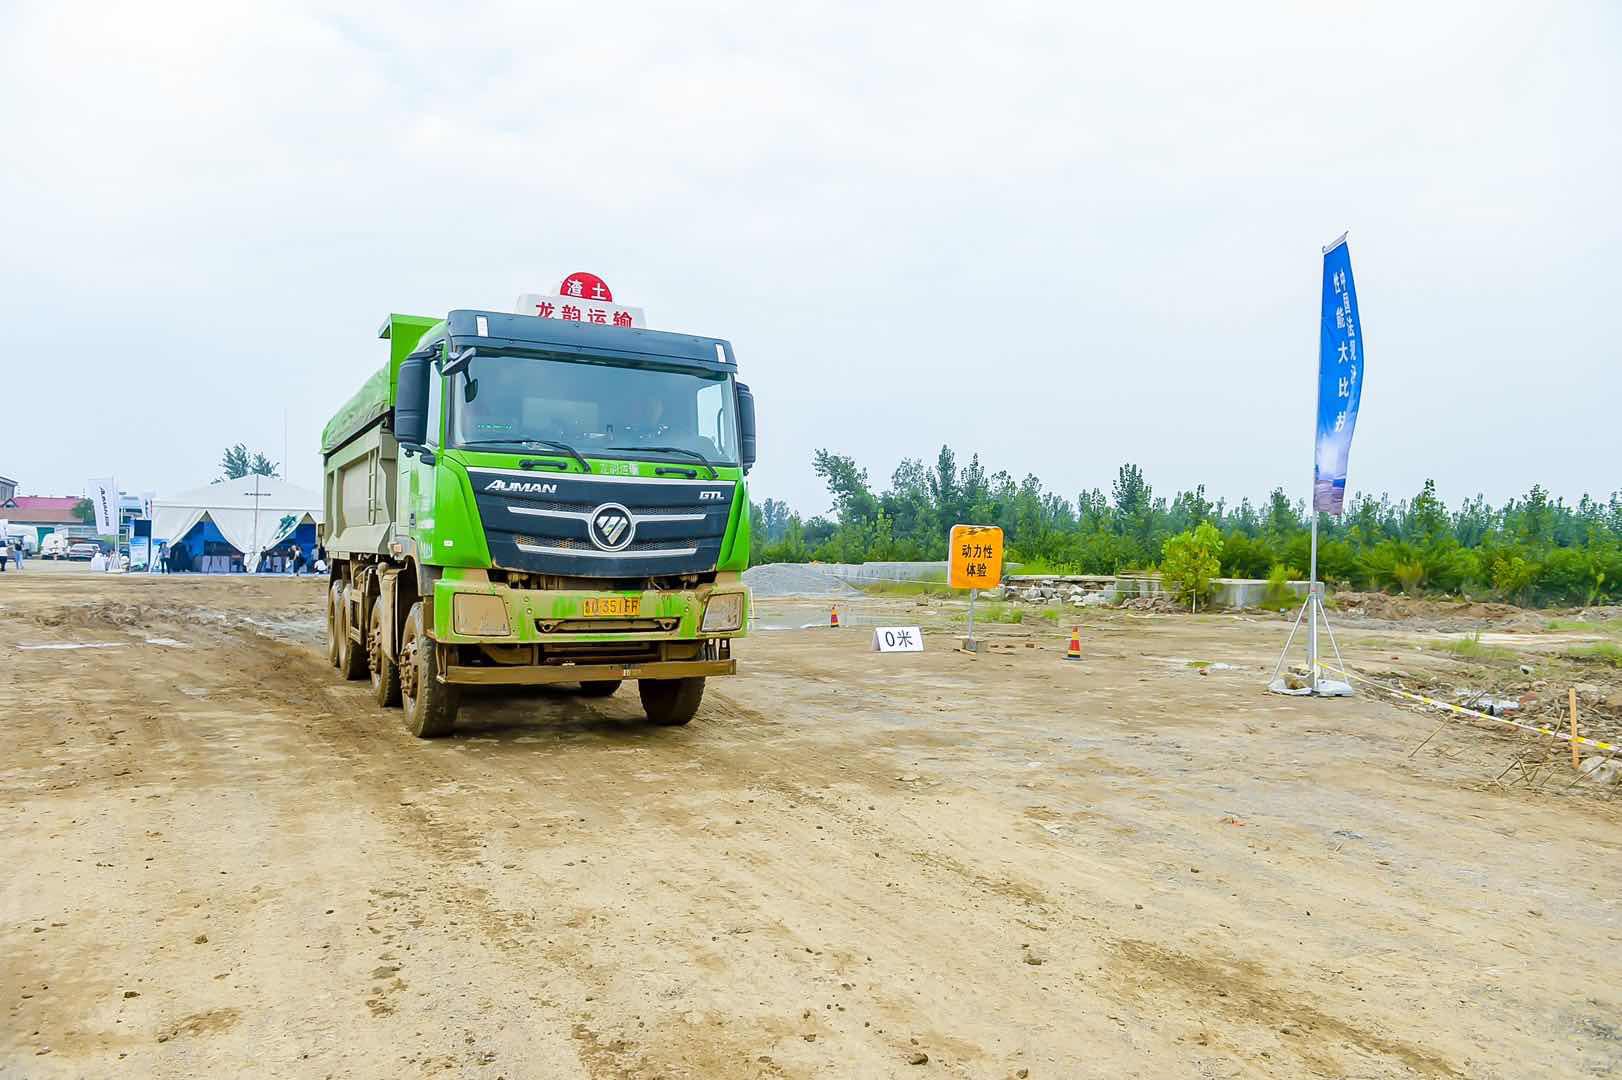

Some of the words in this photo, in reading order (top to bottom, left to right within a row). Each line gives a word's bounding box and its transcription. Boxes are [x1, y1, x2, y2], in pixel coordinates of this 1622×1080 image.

[567, 279, 607, 300] 渣土
[535, 301, 633, 328] 龙韵运输
[484, 479, 558, 494] AUMAN
[698, 490, 725, 500] GTL
[962, 545, 993, 559] 动力性
[966, 563, 987, 578] 体验
[885, 629, 913, 648] 0米
